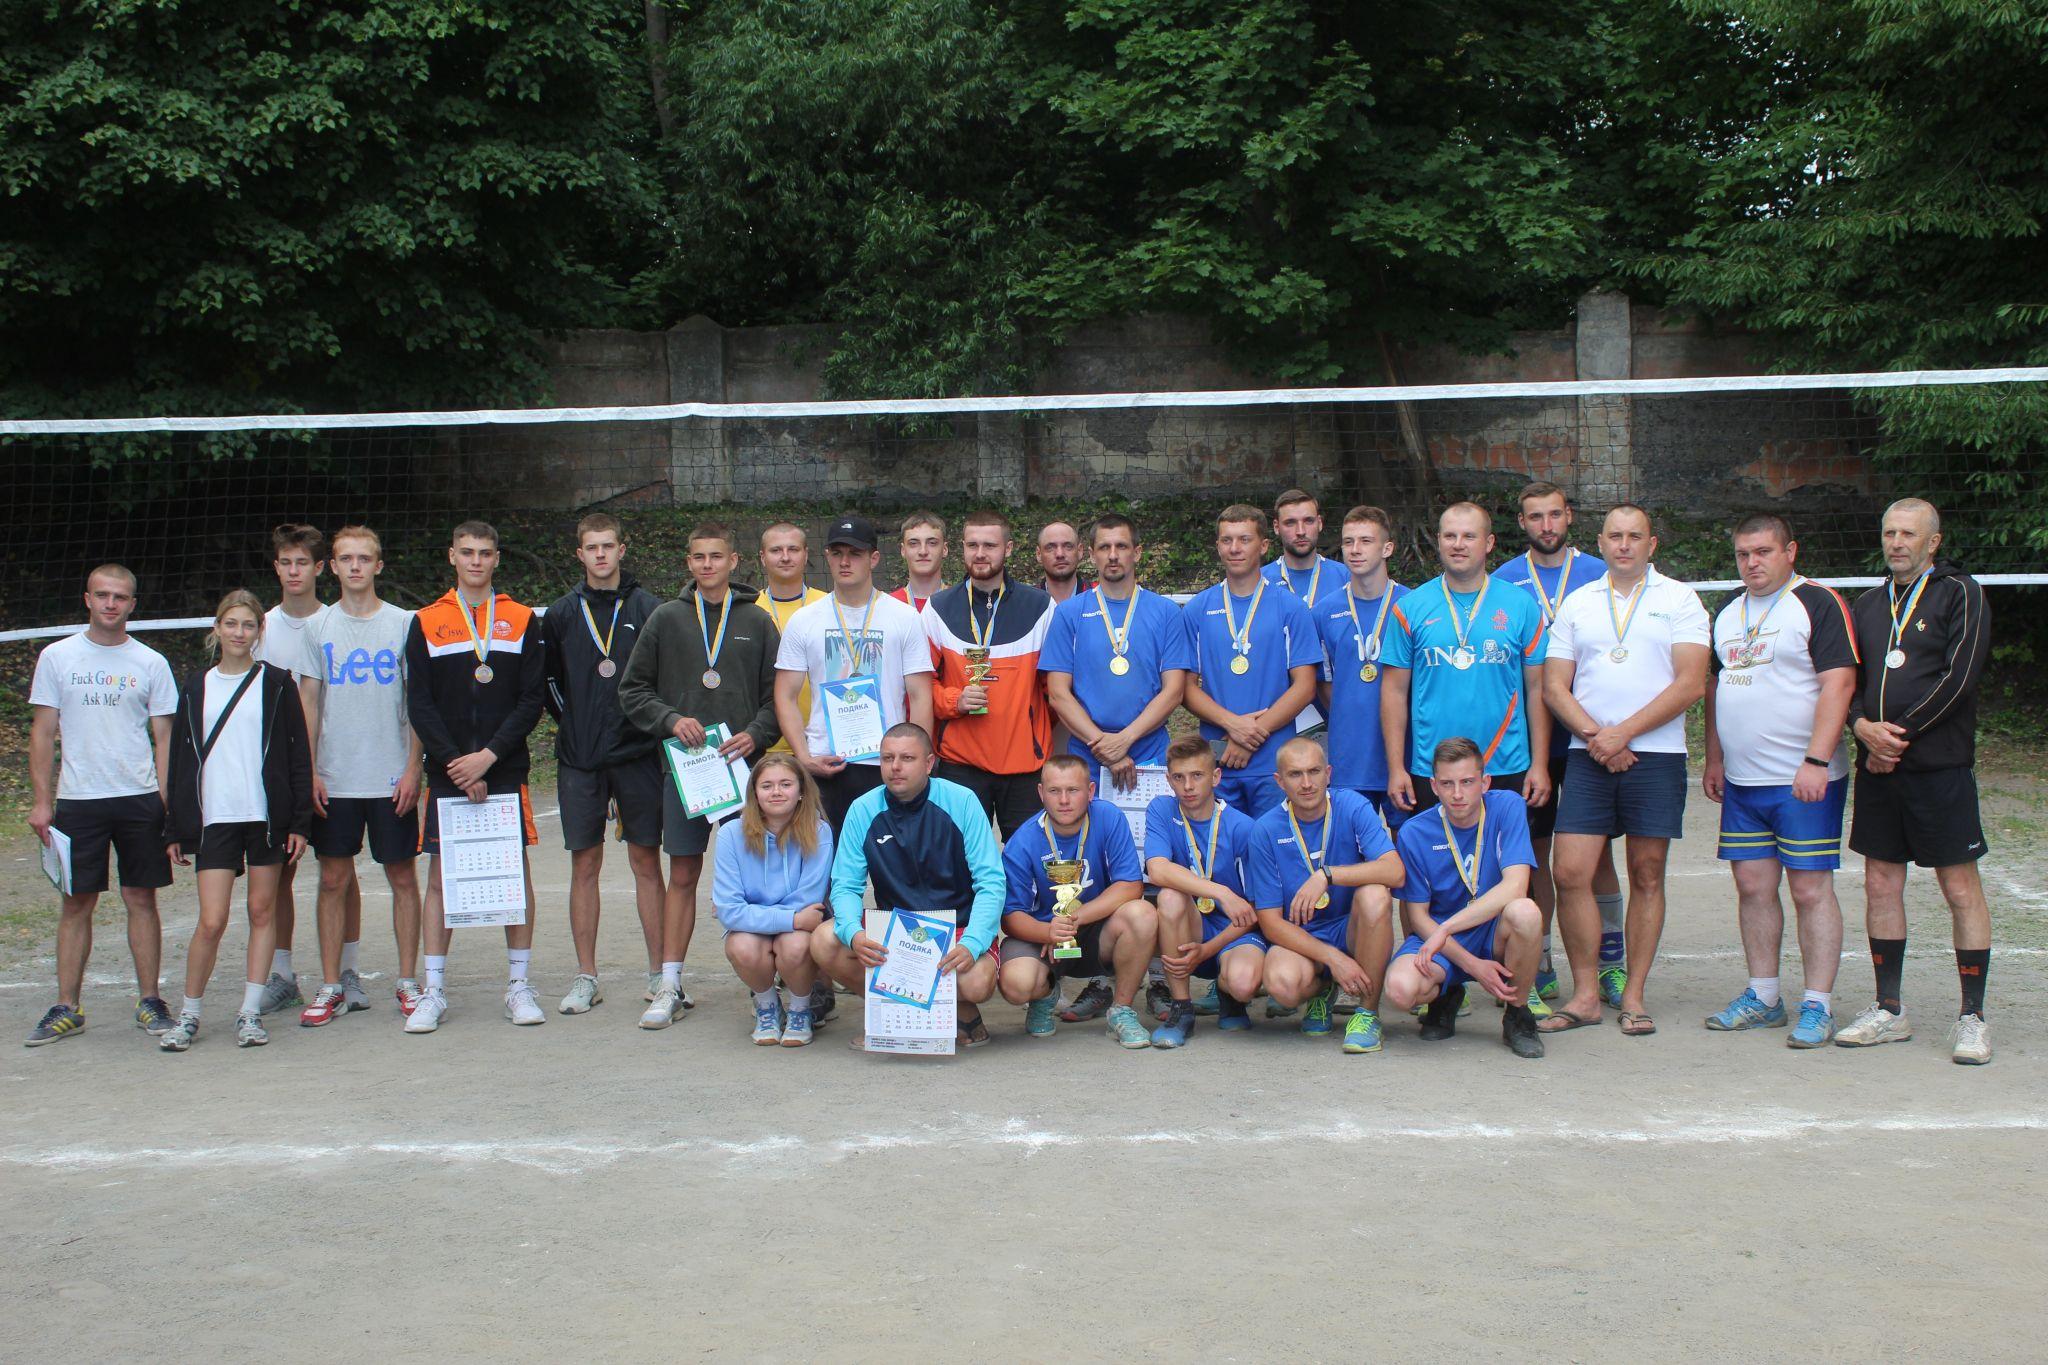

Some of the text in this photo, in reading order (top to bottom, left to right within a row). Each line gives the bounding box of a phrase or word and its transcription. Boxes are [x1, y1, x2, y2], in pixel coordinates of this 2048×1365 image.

[1353, 633, 1381, 662] 10
[322, 641, 397, 686] Lee
[71, 670, 137, 691] Fuck Google
[1726, 673, 1753, 687] 2008
[82, 692, 101, 706] Ask
[838, 703, 869, 714] ПОДЯКА
[683, 753, 716, 768] ГРАМОТА
[899, 940, 932, 955] ПОДЯКА
